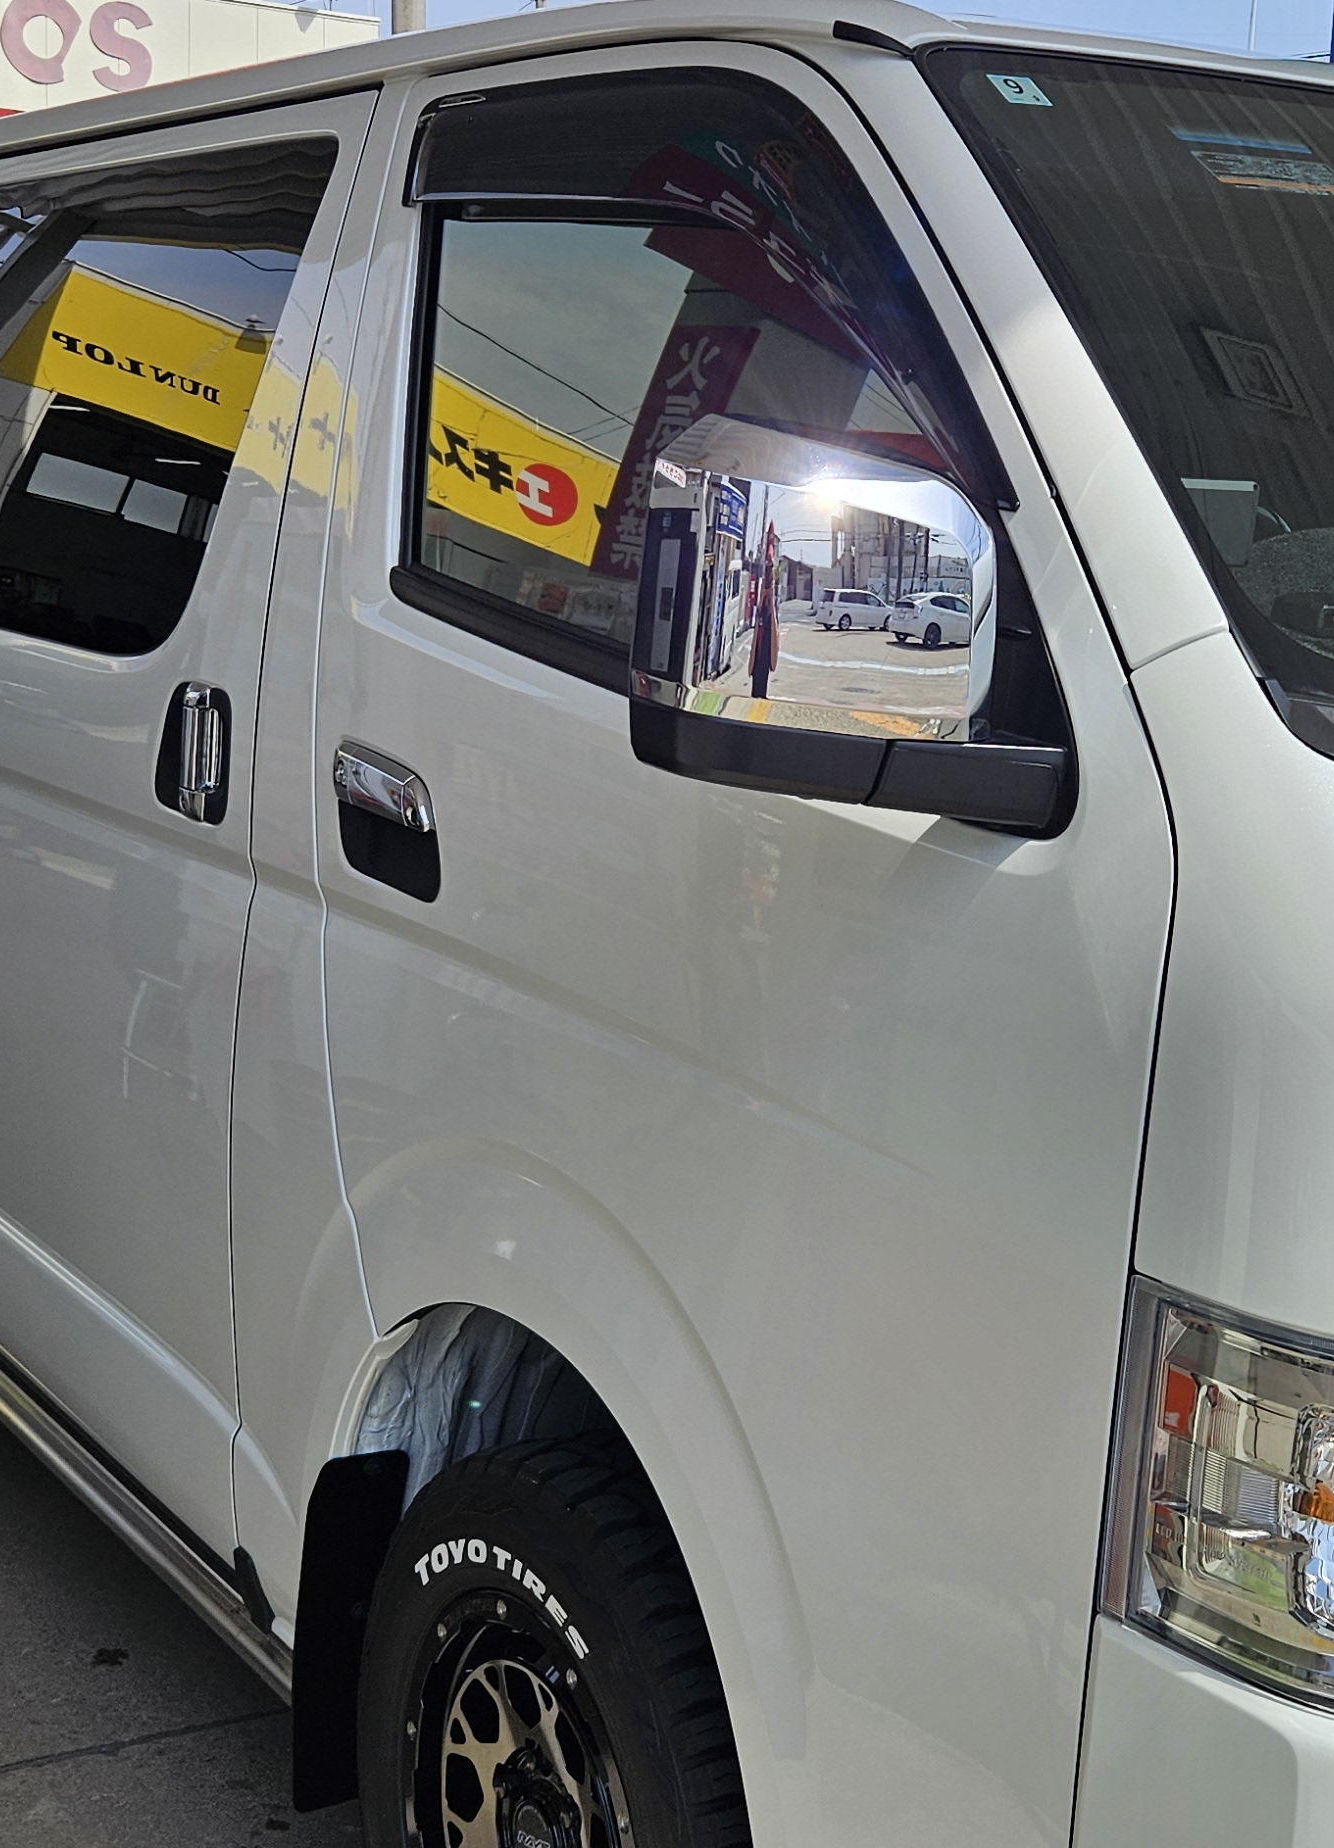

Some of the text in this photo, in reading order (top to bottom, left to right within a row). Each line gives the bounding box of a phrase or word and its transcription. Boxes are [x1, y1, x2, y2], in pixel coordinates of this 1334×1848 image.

[1003, 78, 1024, 94] 9
[414, 1538, 590, 1660] TOYO TIRES
